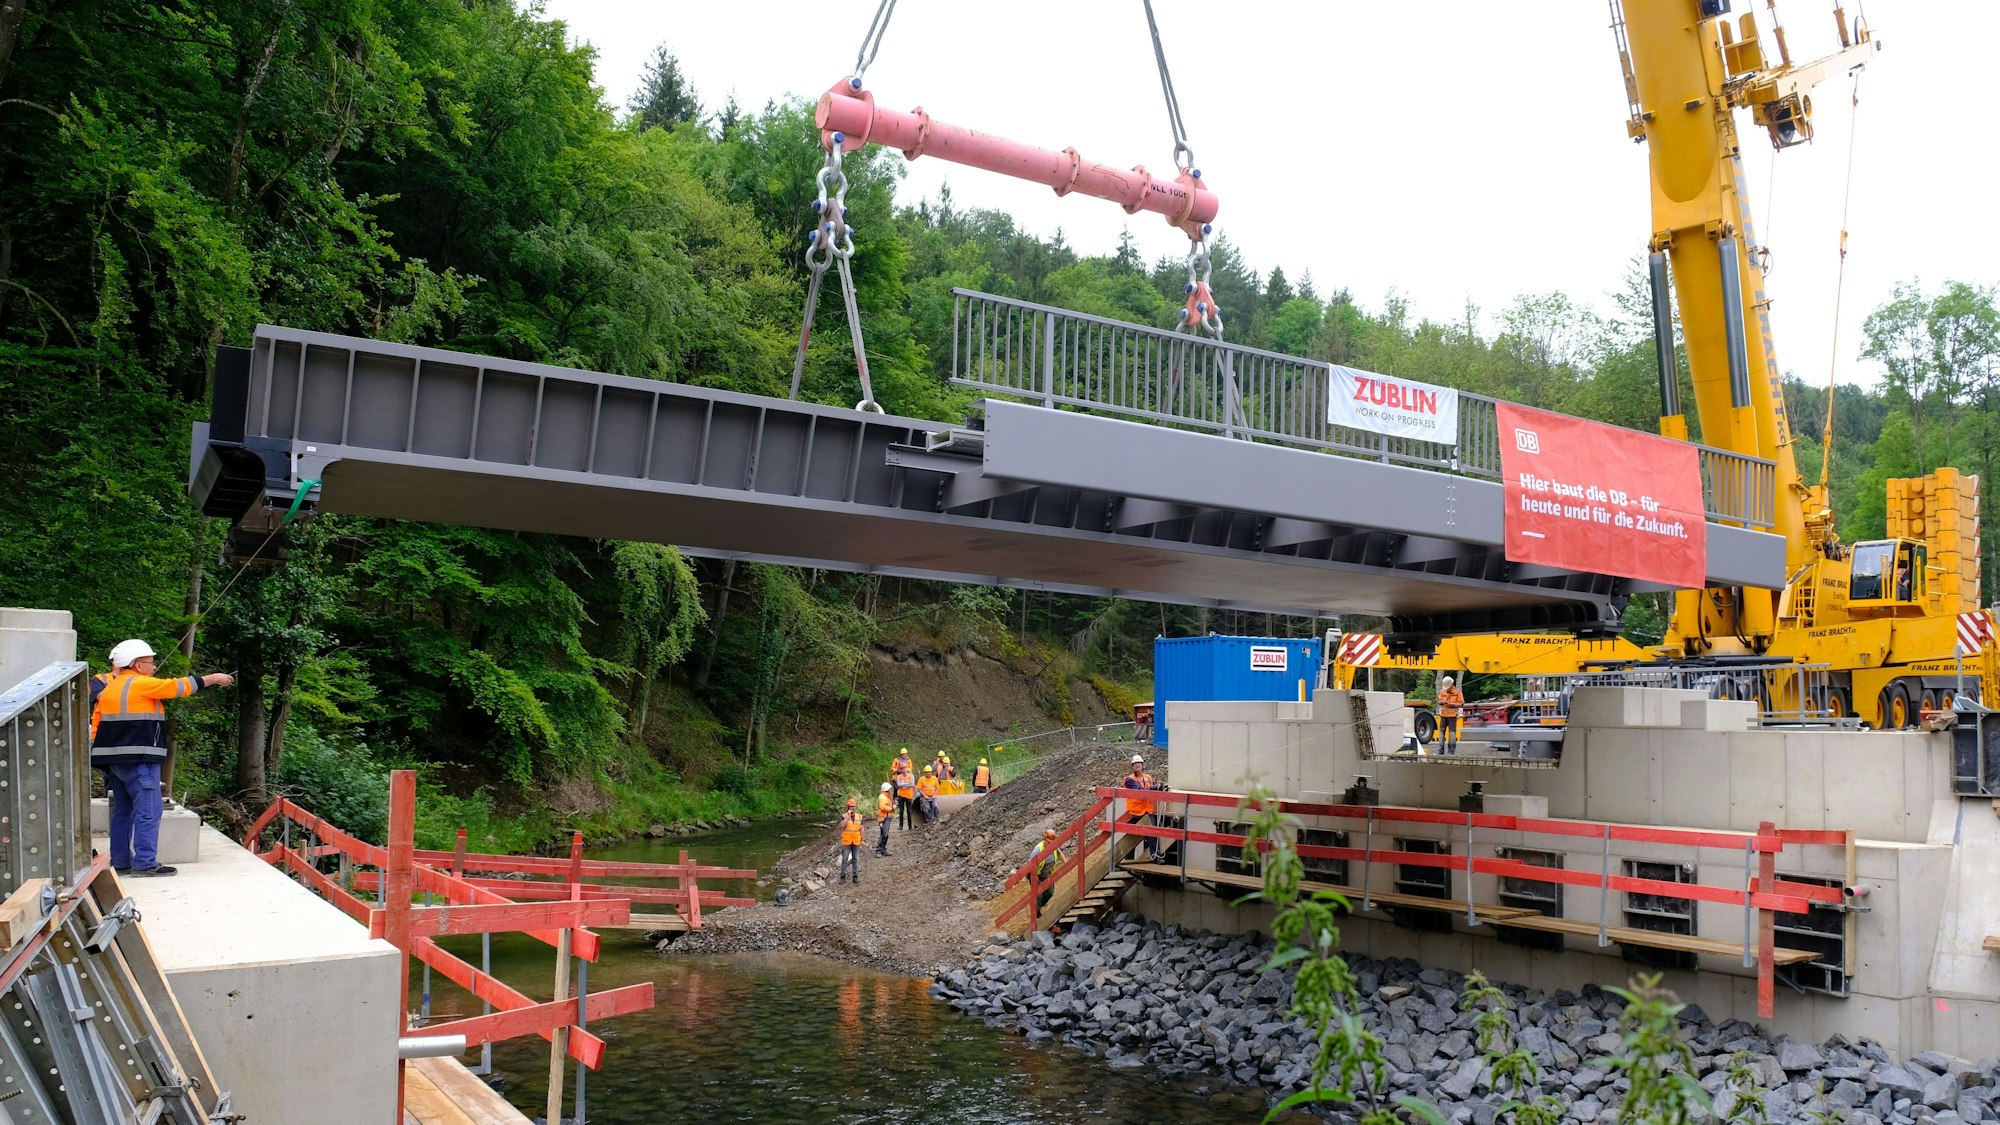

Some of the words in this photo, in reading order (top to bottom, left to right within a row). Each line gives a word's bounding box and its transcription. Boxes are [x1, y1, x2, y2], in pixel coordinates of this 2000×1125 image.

[1755, 291, 1785, 421] BRACHT
[1353, 376, 1437, 415] ZÜBLIN
[1381, 412, 1394, 421] ON
[1397, 415, 1436, 429] PROGRESS
[1517, 430, 1538, 451] DB
[1519, 473, 1550, 491] Hier
[1552, 478, 1584, 499] baut
[1586, 485, 1608, 503] die
[1609, 489, 1628, 507] DB
[1640, 495, 1660, 513] für
[1521, 494, 1561, 516] heute
[1564, 505, 1590, 521] und
[1592, 506, 1612, 524] für
[1614, 511, 1634, 529] die
[1636, 515, 1688, 539] Zukunft.
[1837, 580, 1848, 589] BRAC
[1808, 629, 1827, 638] FRANZ
[1829, 627, 1852, 636] BRACHT
